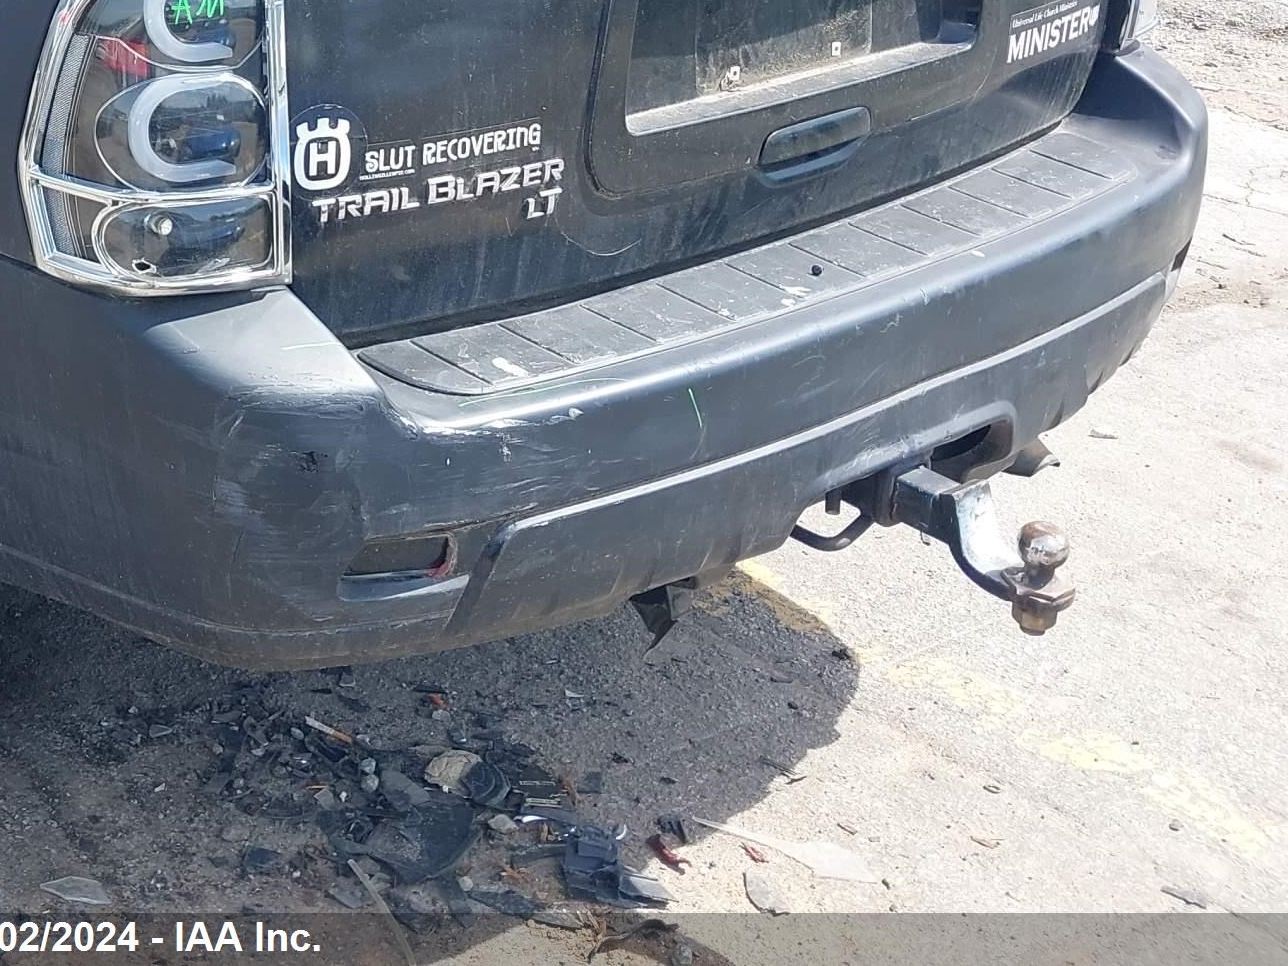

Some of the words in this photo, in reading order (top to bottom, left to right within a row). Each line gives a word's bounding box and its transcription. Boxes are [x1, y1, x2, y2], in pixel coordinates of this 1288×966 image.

[1006, 6, 1091, 63] MINISTER
[364, 145, 416, 173] SLUT
[422, 123, 541, 166] RECOVERING
[312, 187, 420, 222] TRAIL
[426, 158, 564, 205] BLAZER
[526, 187, 562, 219] LT
